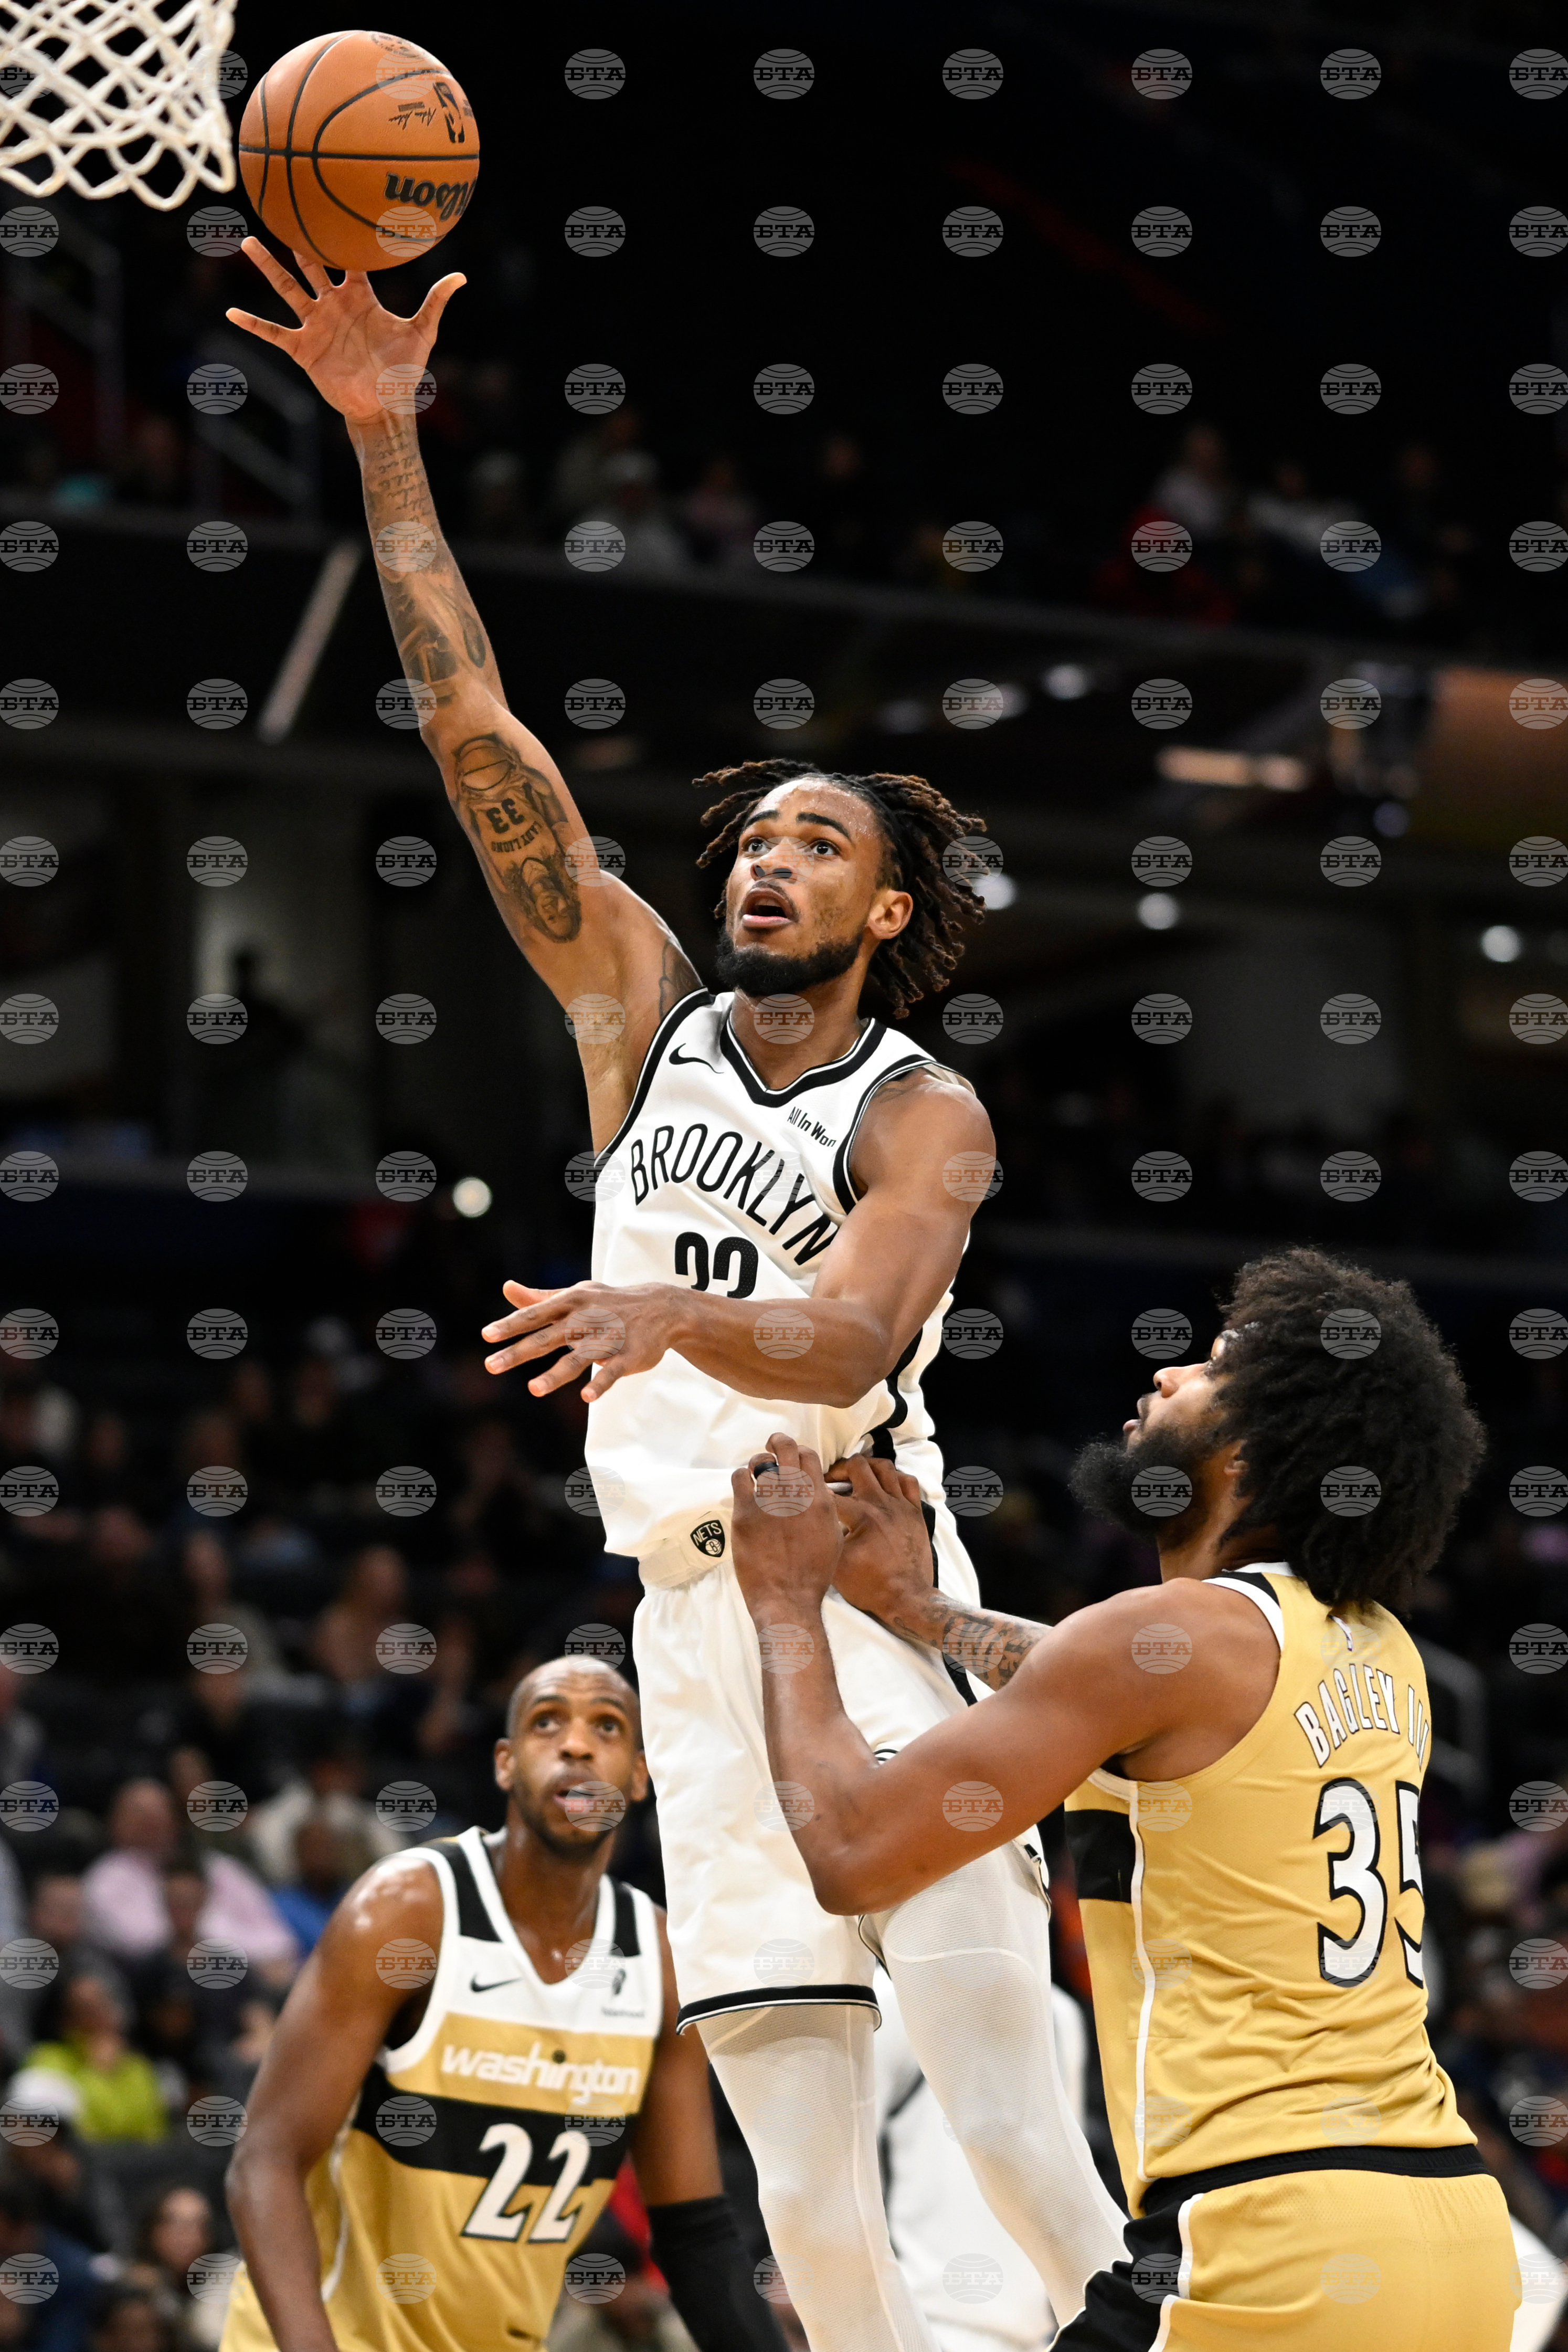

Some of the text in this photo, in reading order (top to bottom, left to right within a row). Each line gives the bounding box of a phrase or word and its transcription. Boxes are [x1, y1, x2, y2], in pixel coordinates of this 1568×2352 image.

[486, 798, 524, 834] 33
[787, 1106, 837, 1147] All In Won
[631, 1123, 840, 1265] BROOKLYN
[693, 1522, 722, 1546] NETS
[1294, 1662, 1401, 1769] BAGLEY
[441, 2040, 640, 2106] washington
[460, 2122, 591, 2243] 22
